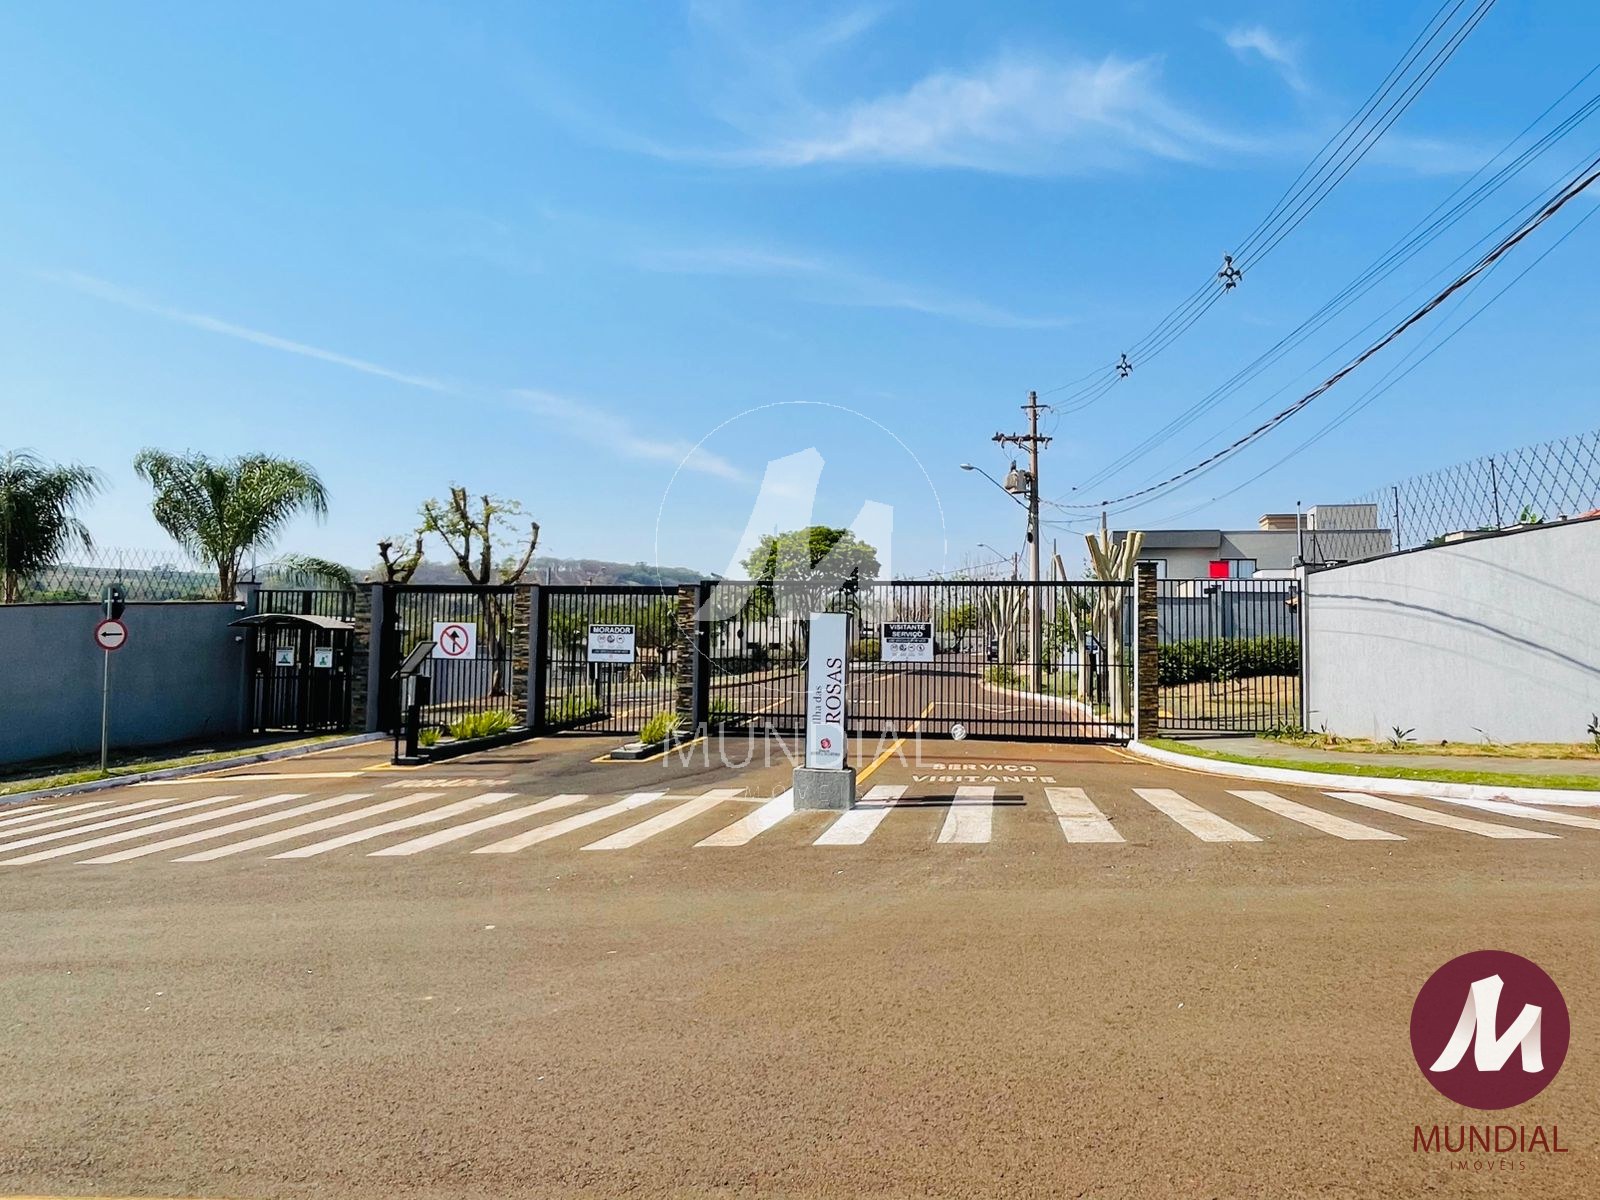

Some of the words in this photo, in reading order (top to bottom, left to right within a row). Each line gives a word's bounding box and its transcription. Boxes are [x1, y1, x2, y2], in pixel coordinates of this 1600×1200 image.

[593, 626, 631, 634] MORADOR
[813, 685, 822, 703] das
[825, 658, 843, 724] ROSAS
[812, 706, 822, 724] Ilha
[912, 775, 1057, 783] VISITANTE
